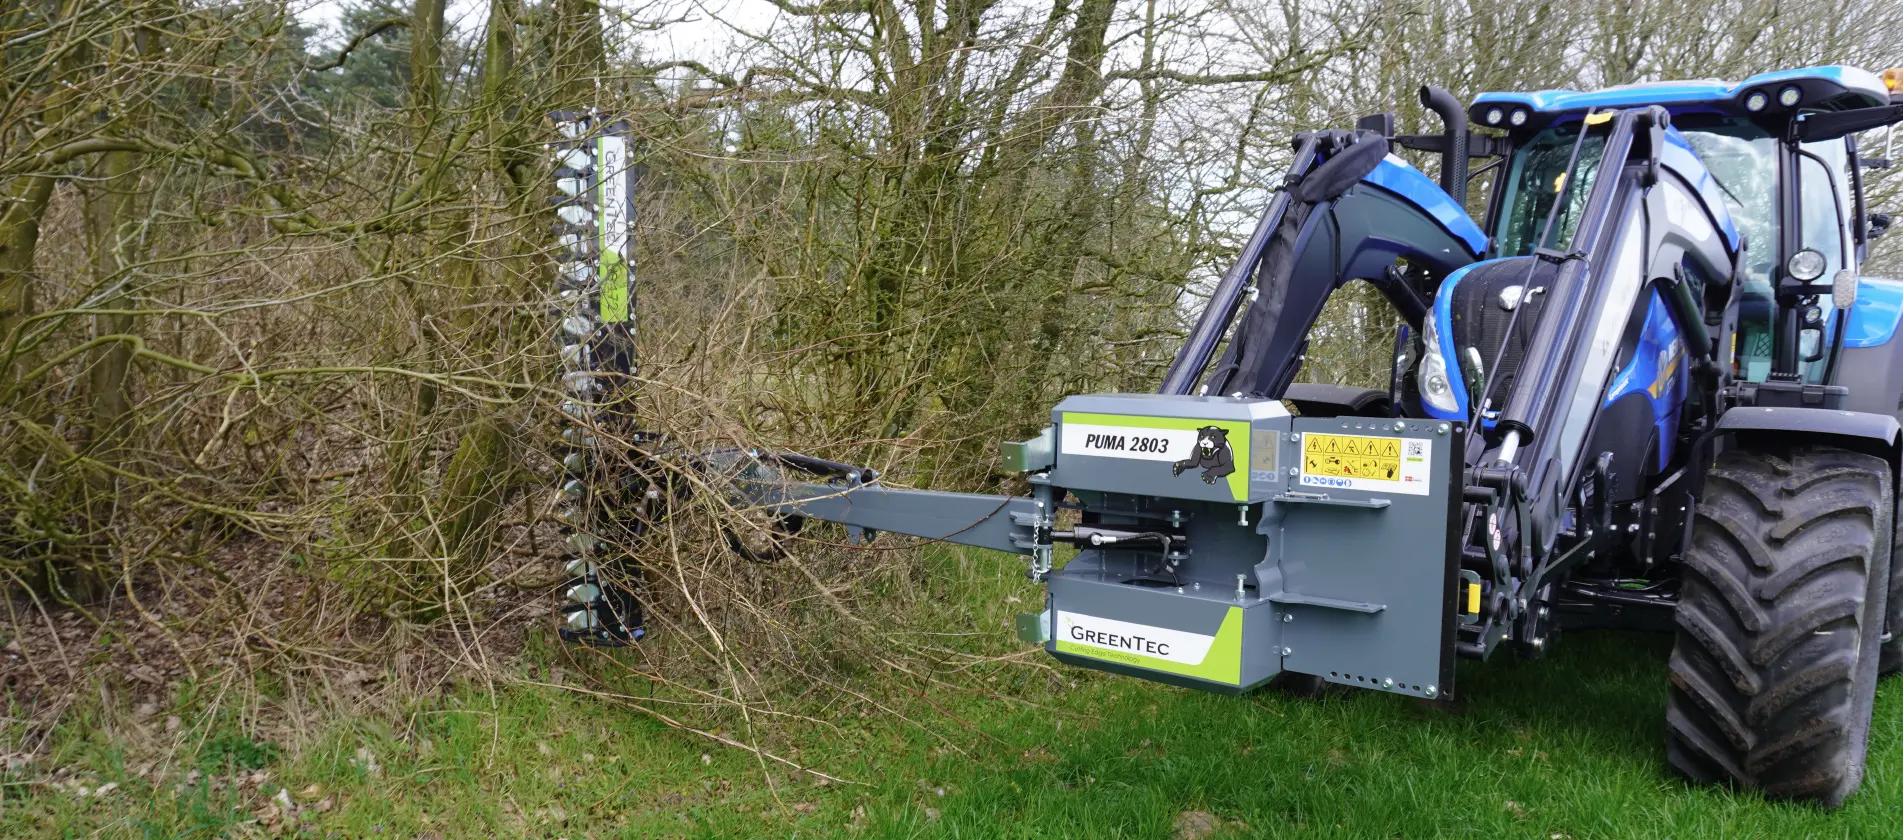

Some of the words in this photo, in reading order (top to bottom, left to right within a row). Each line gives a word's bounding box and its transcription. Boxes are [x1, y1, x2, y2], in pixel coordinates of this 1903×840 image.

[1085, 434, 1125, 450] PUMA
[1129, 437, 1169, 453] 2803
[1070, 644, 1091, 655] Cutting
[1091, 649, 1106, 659] Edge
[1107, 651, 1140, 664] Technology
